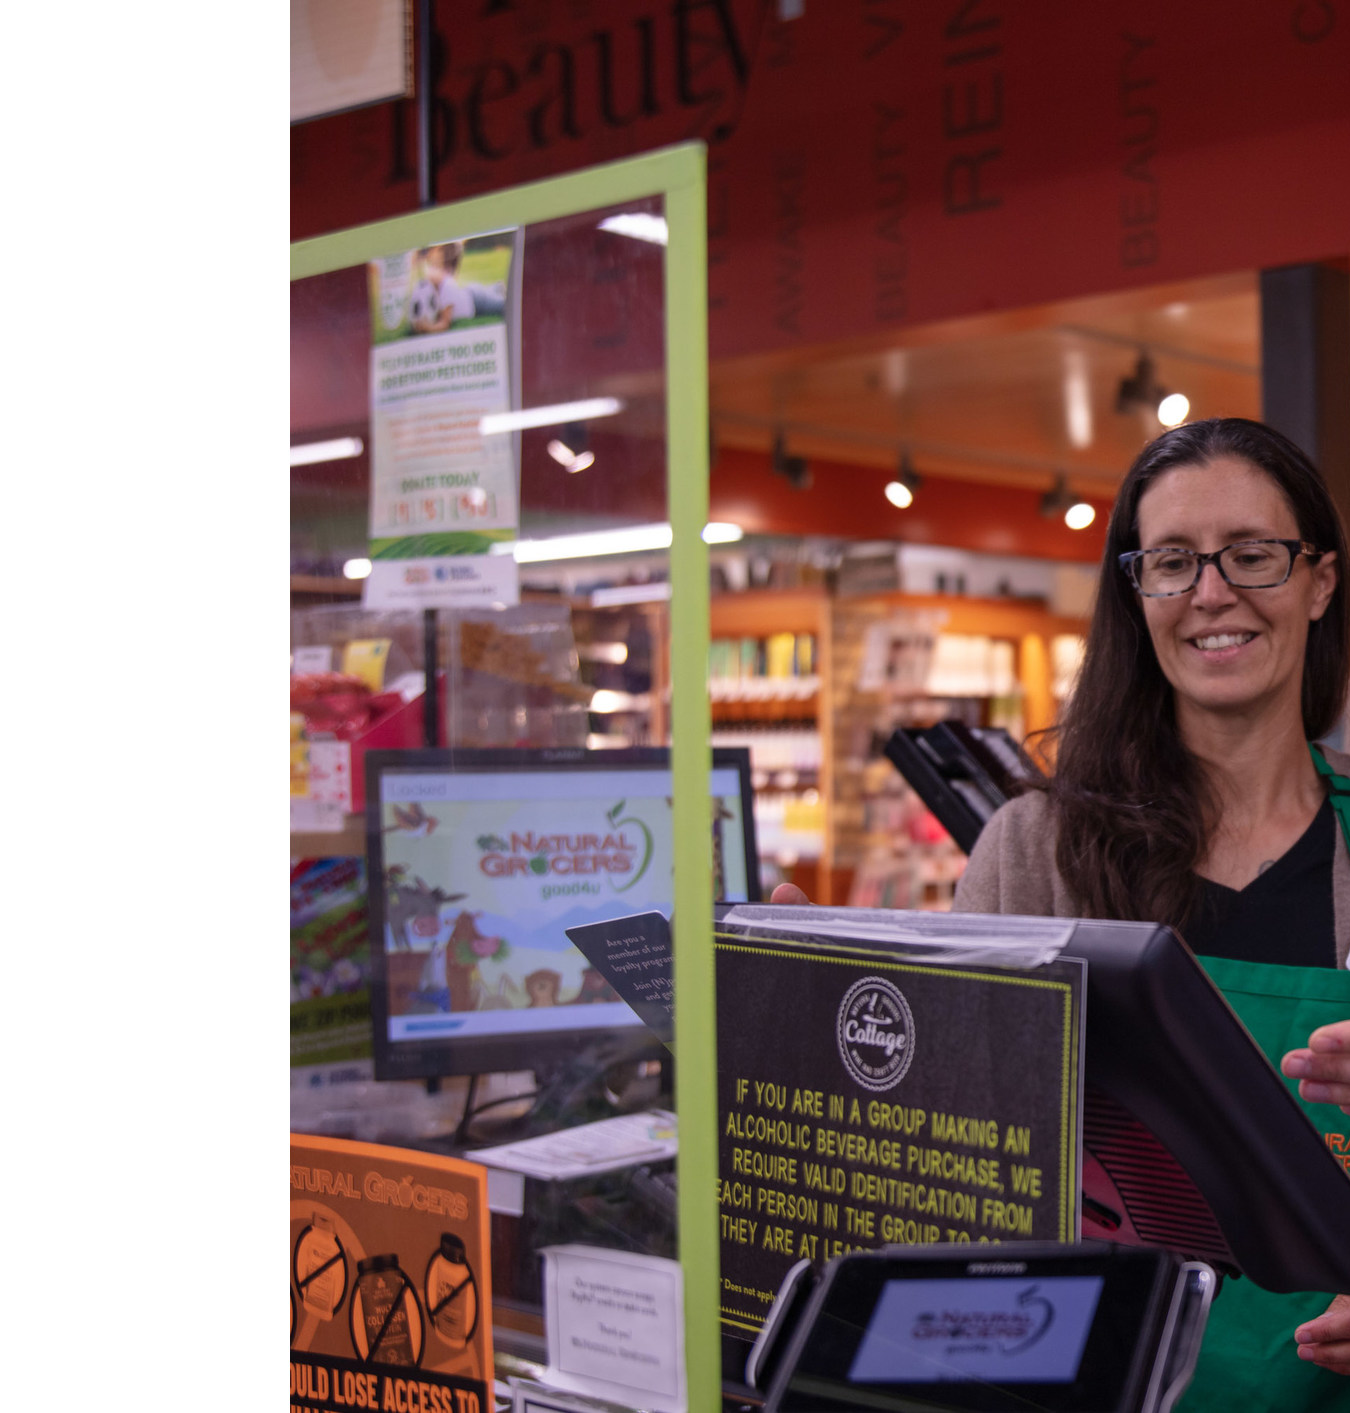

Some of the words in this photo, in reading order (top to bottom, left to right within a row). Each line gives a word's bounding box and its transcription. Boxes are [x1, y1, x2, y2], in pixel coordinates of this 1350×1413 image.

[1121, 31, 1160, 270] BEAUTY
[510, 831, 636, 853] NATURAL
[478, 850, 635, 877] GROCERS
[606, 938, 622, 947] Are
[623, 936, 639, 947] you
[607, 949, 640, 960] member
[642, 944, 651, 954] of
[652, 944, 666, 952] our
[610, 961, 641, 974] loyalty
[633, 980, 652, 991] Join
[845, 1019, 906, 1057] Cottage
[736, 1078, 749, 1103] IF
[755, 1081, 786, 1111] YOU
[792, 1088, 824, 1119] ARE
[829, 1094, 844, 1122] IN
[849, 1099, 861, 1125] A
[867, 1101, 927, 1136] GROUP
[932, 1111, 998, 1150] MAKING
[1004, 1125, 1031, 1157] AN
[726, 1112, 812, 1151] ALCOHOLIC
[816, 1130, 901, 1169] BEVERAGE
[907, 1147, 1005, 1193] PURCHASE,
[1011, 1165, 1042, 1198] WE
[364, 1171, 469, 1221] GROCERS
[716, 1178, 752, 1212] EACH
[757, 1187, 818, 1226] PERSON
[824, 1201, 838, 1229] IN
[845, 1206, 875, 1237] THE
[881, 1212, 941, 1246] GROUP
[946, 1228, 971, 1246] TO
[733, 1148, 797, 1186] REQUIRE
[803, 1162, 847, 1194] VALID
[851, 1170, 977, 1222] IDENTIFICATION
[982, 1198, 1034, 1235] FROM
[721, 1213, 758, 1248] THEY
[763, 1225, 794, 1256] ARE
[799, 1233, 819, 1260] AT
[824, 1238, 875, 1262] LEA
[724, 1278, 742, 1293] Does
[743, 1286, 756, 1297] not
[757, 1289, 777, 1304] apply
[332, 1368, 379, 1410] LOSE
[384, 1376, 453, 1413] ACCESS
[455, 1388, 480, 1413] TO
